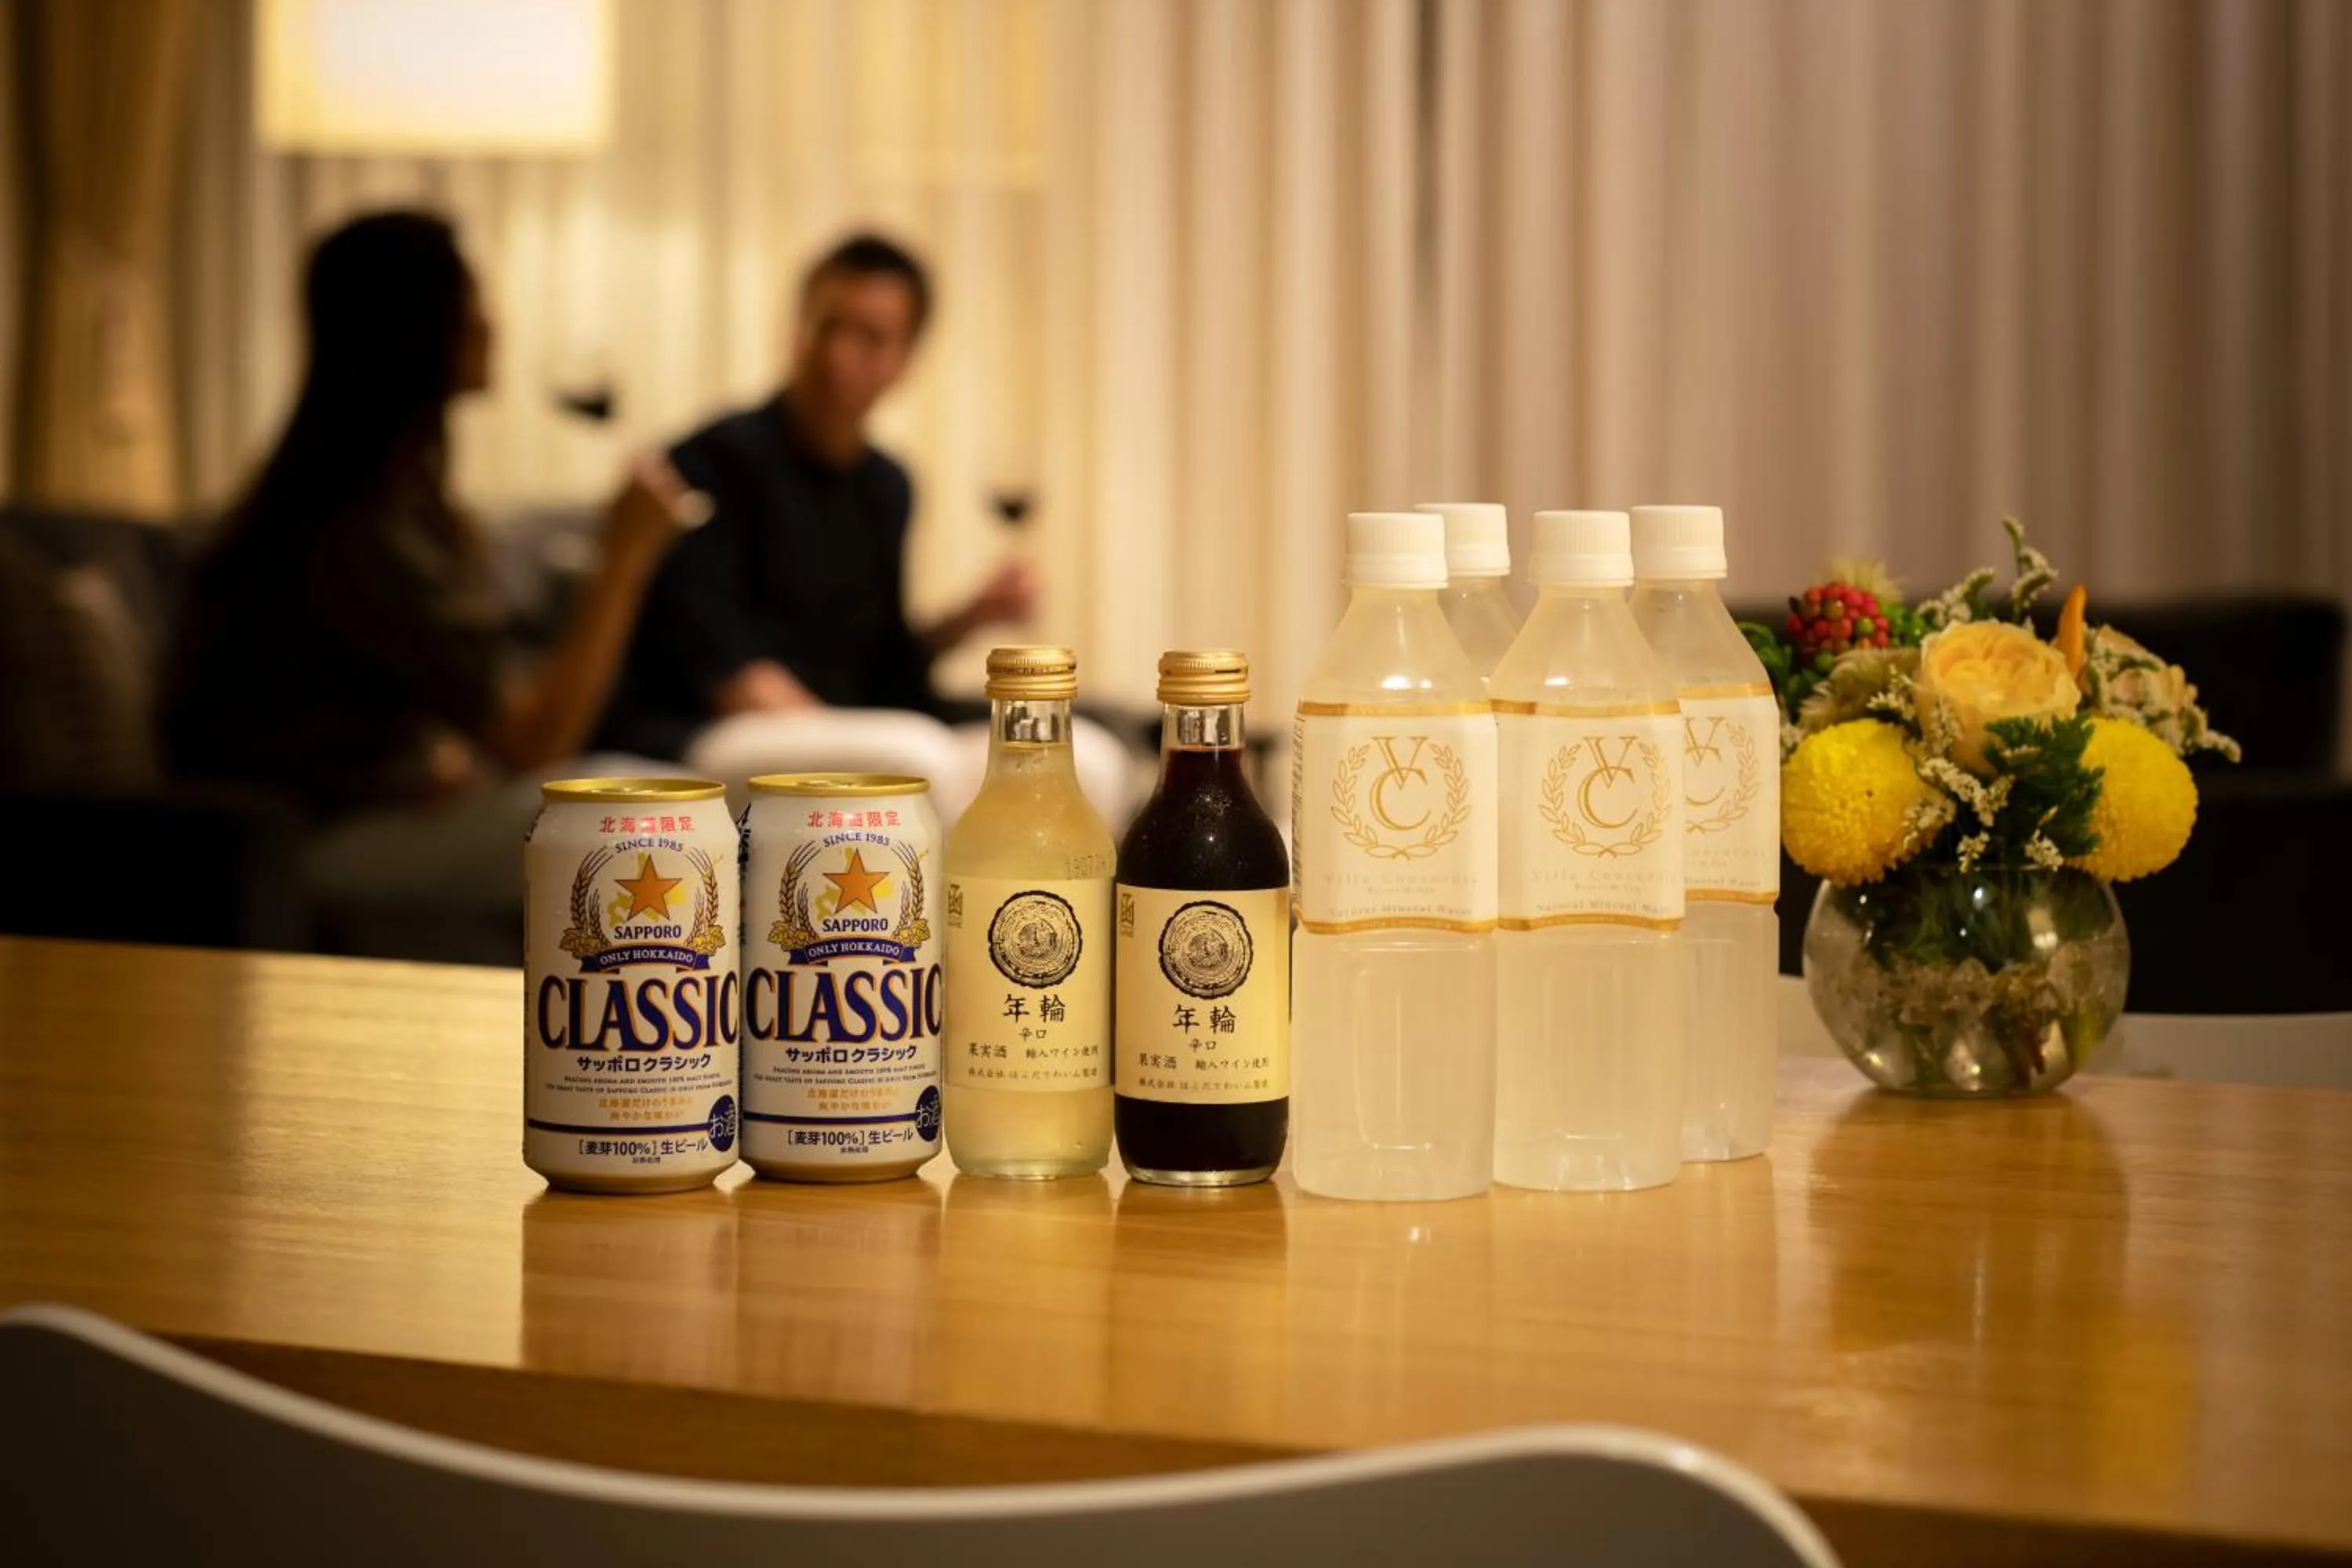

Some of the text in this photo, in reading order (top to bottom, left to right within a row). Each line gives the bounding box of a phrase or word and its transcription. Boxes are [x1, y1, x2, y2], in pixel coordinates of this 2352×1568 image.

[599, 816, 695, 833] 北海道限定
[808, 810, 901, 828] 北海道限定
[615, 837, 684, 855] SINCE 1985
[823, 833, 862, 848] SINCE
[614, 925, 682, 940] SAPPORO
[823, 918, 889, 932] SAPPORO
[599, 949, 694, 966] ONLY HOKKAIDO
[808, 942, 900, 958] ONLY HOKKAIDO
[538, 971, 739, 1052] CLASSIC
[746, 964, 942, 1043] CLASSIC
[1003, 993, 1066, 1022] 年輪
[1172, 1004, 1236, 1035] 年輪
[1018, 1027, 1047, 1042] 辛口
[968, 1042, 1007, 1058] 果実酒
[1188, 1038, 1217, 1052] 辛口
[785, 1045, 917, 1063] サッポロクラシック
[1138, 1053, 1177, 1069] 果実酒
[576, 1054, 712, 1073] サッポロクラシック
